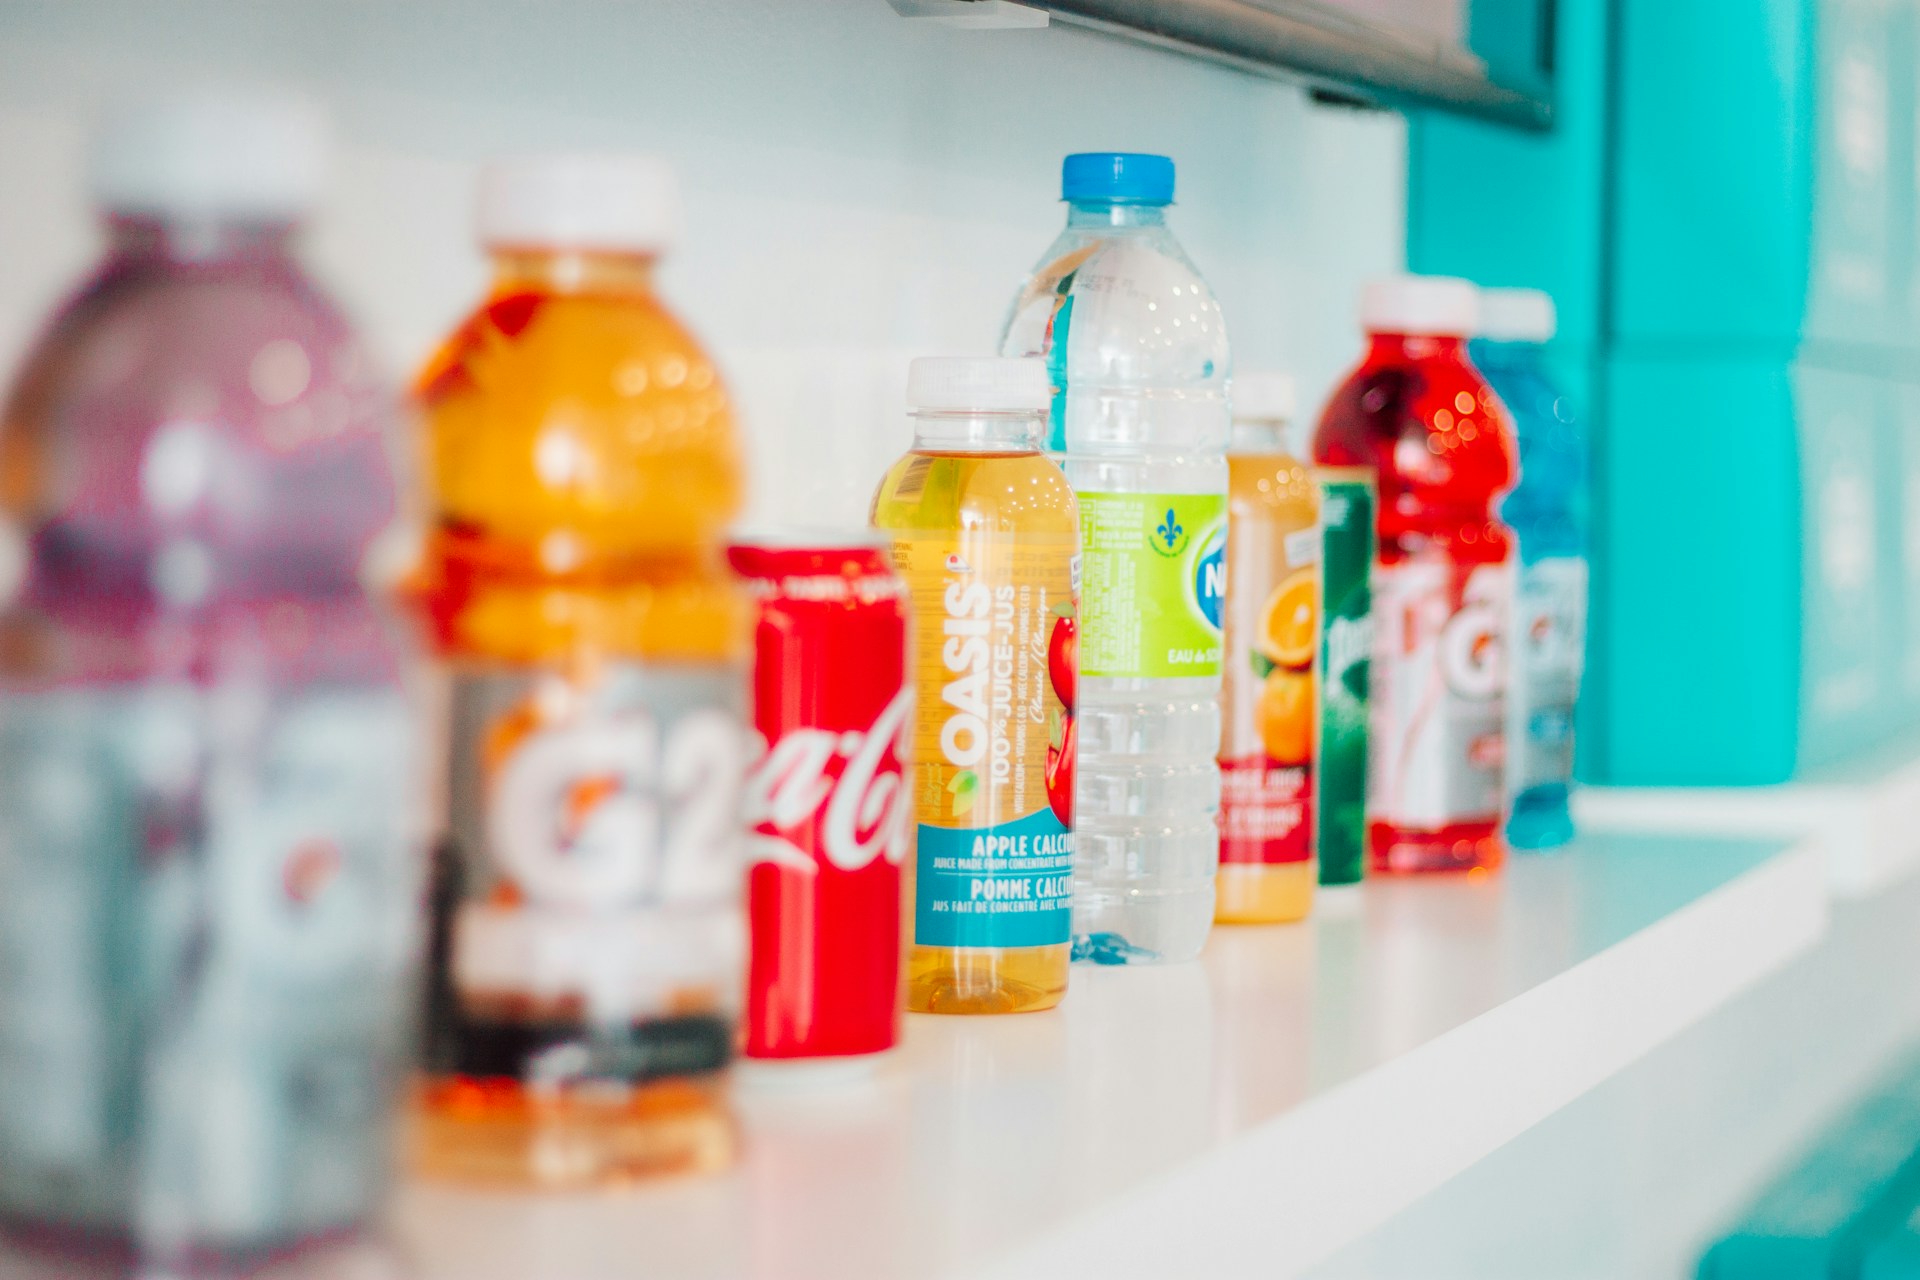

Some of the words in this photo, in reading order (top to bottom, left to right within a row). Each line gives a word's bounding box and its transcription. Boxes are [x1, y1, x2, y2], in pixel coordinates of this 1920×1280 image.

[1019, 607, 1030, 645] VITAMINES
[993, 585, 1015, 716] JUICE-JUS
[1168, 649, 1193, 664] EAU
[942, 583, 991, 766] OASIS
[1018, 651, 1029, 682] CALCIUM
[991, 719, 1010, 785] 100%
[1016, 723, 1027, 757] VITAMINS
[1014, 763, 1026, 793] CALCIUM
[1014, 793, 1025, 814] WITH
[971, 835, 1028, 857] APPLE
[933, 857, 956, 869] JUICE
[957, 857, 983, 870] MADE
[983, 858, 1008, 870] FROM
[1008, 857, 1055, 870] CONCENTRATE
[971, 878, 1031, 900] POMME
[932, 900, 949, 912] JUS
[952, 900, 973, 913] FAIT
[975, 901, 988, 913] DE
[990, 899, 1038, 914] CONCENTRÉ
[1039, 898, 1056, 911] AVEC
